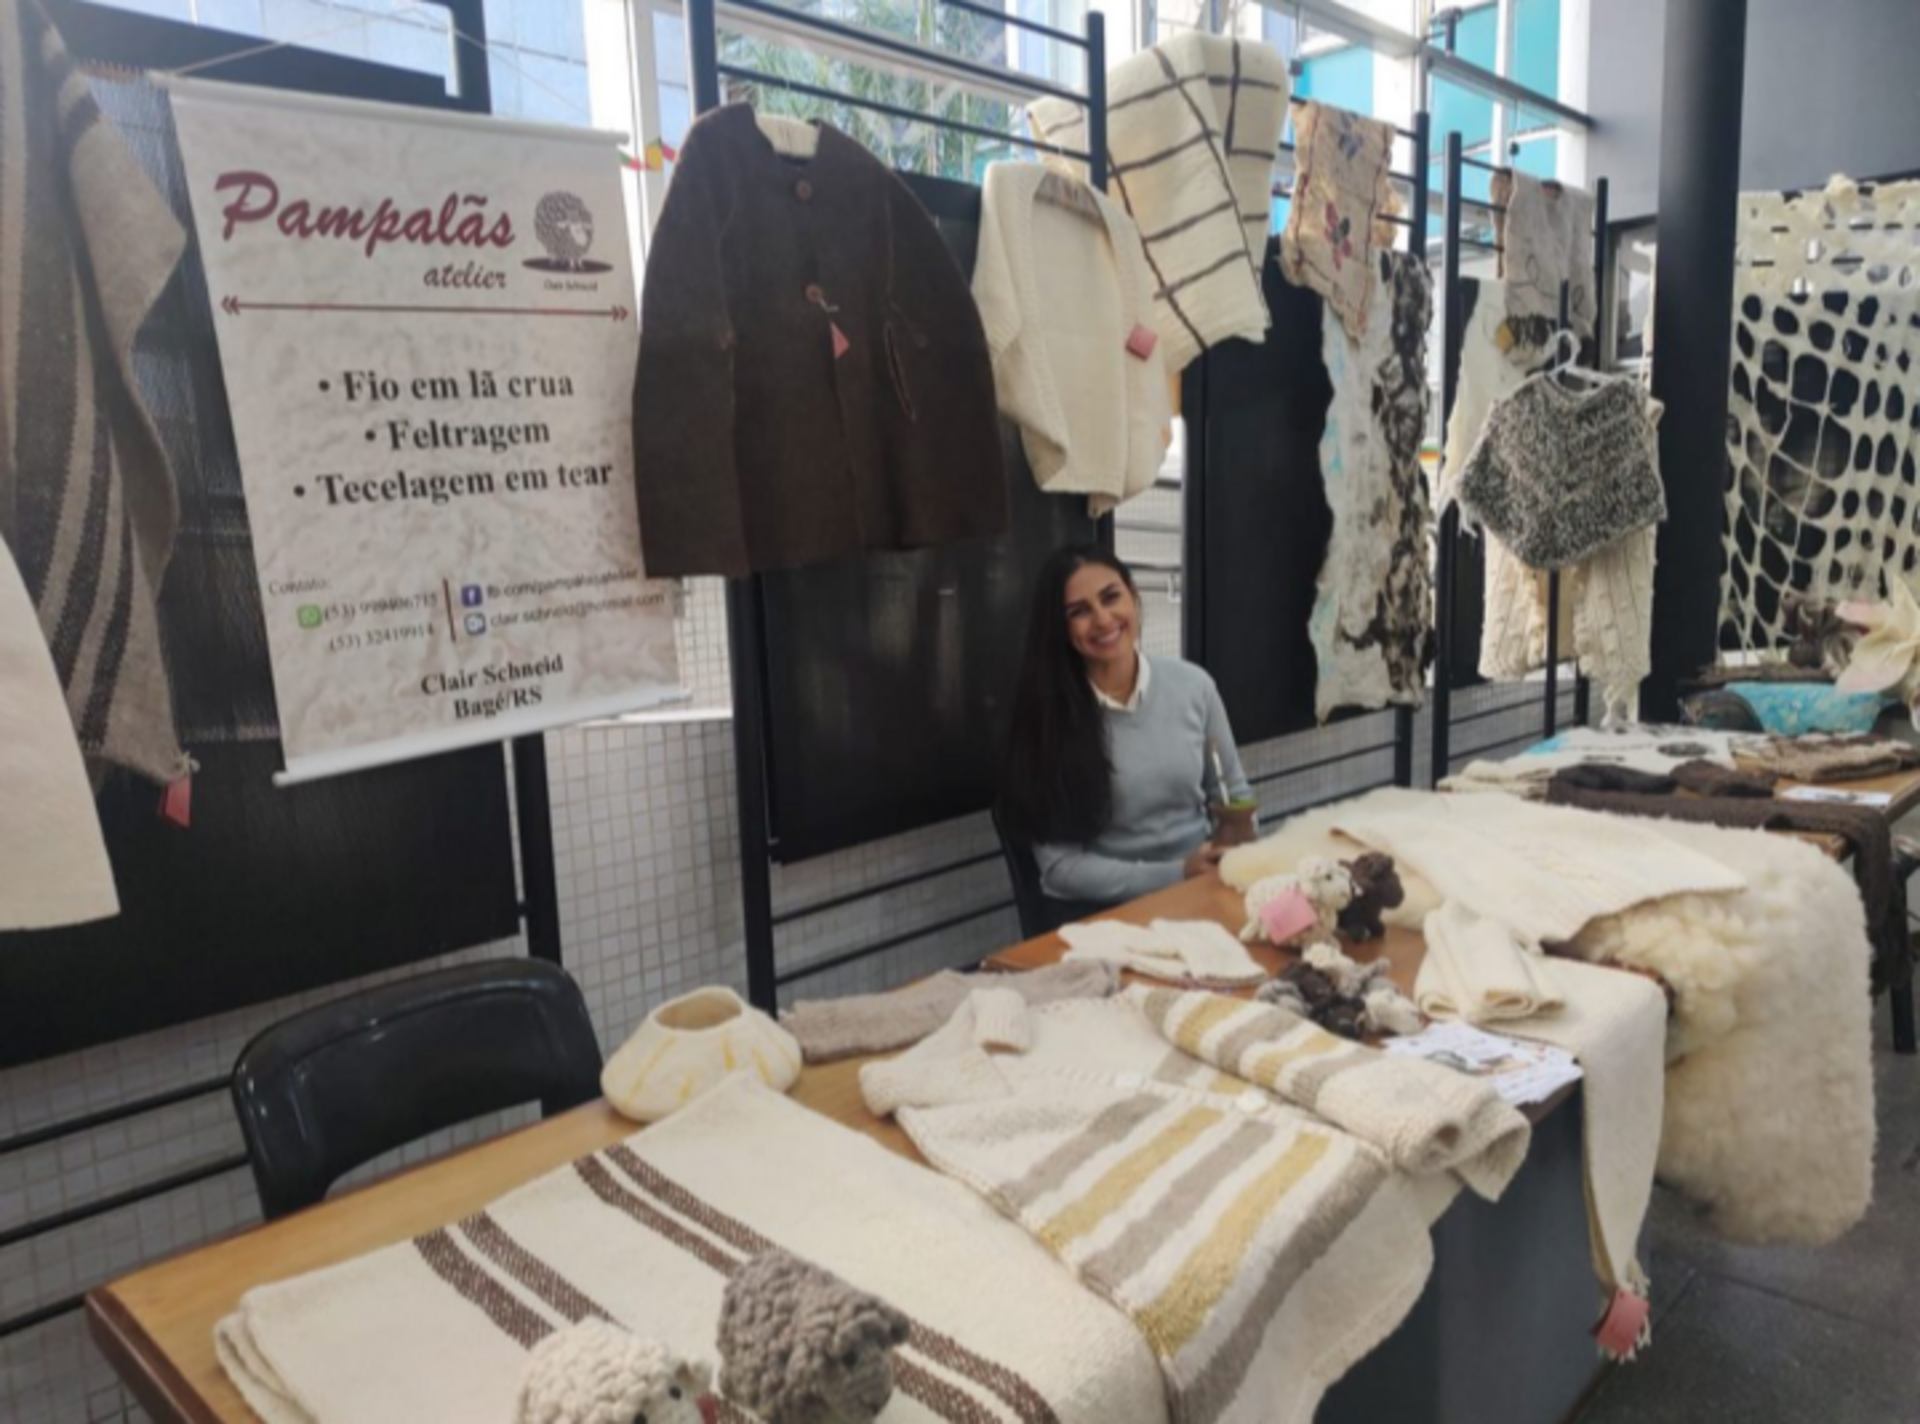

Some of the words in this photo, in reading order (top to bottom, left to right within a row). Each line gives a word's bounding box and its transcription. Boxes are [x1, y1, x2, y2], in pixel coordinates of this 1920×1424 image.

[215, 170, 515, 257] Pampalãs
[423, 261, 507, 290] atelier
[343, 370, 399, 402] Fio
[411, 376, 459, 400] em
[469, 369, 498, 399] lã
[508, 374, 574, 398] crua
[387, 419, 551, 453] Feltragem
[316, 470, 495, 505] Tecelagem
[505, 466, 548, 493] em
[558, 461, 613, 488] tear
[325, 603, 355, 622] (53)
[330, 633, 361, 652] (53)
[421, 669, 478, 696] Clair
[482, 653, 564, 687] Schneid
[454, 684, 543, 720] Bagé/RS
